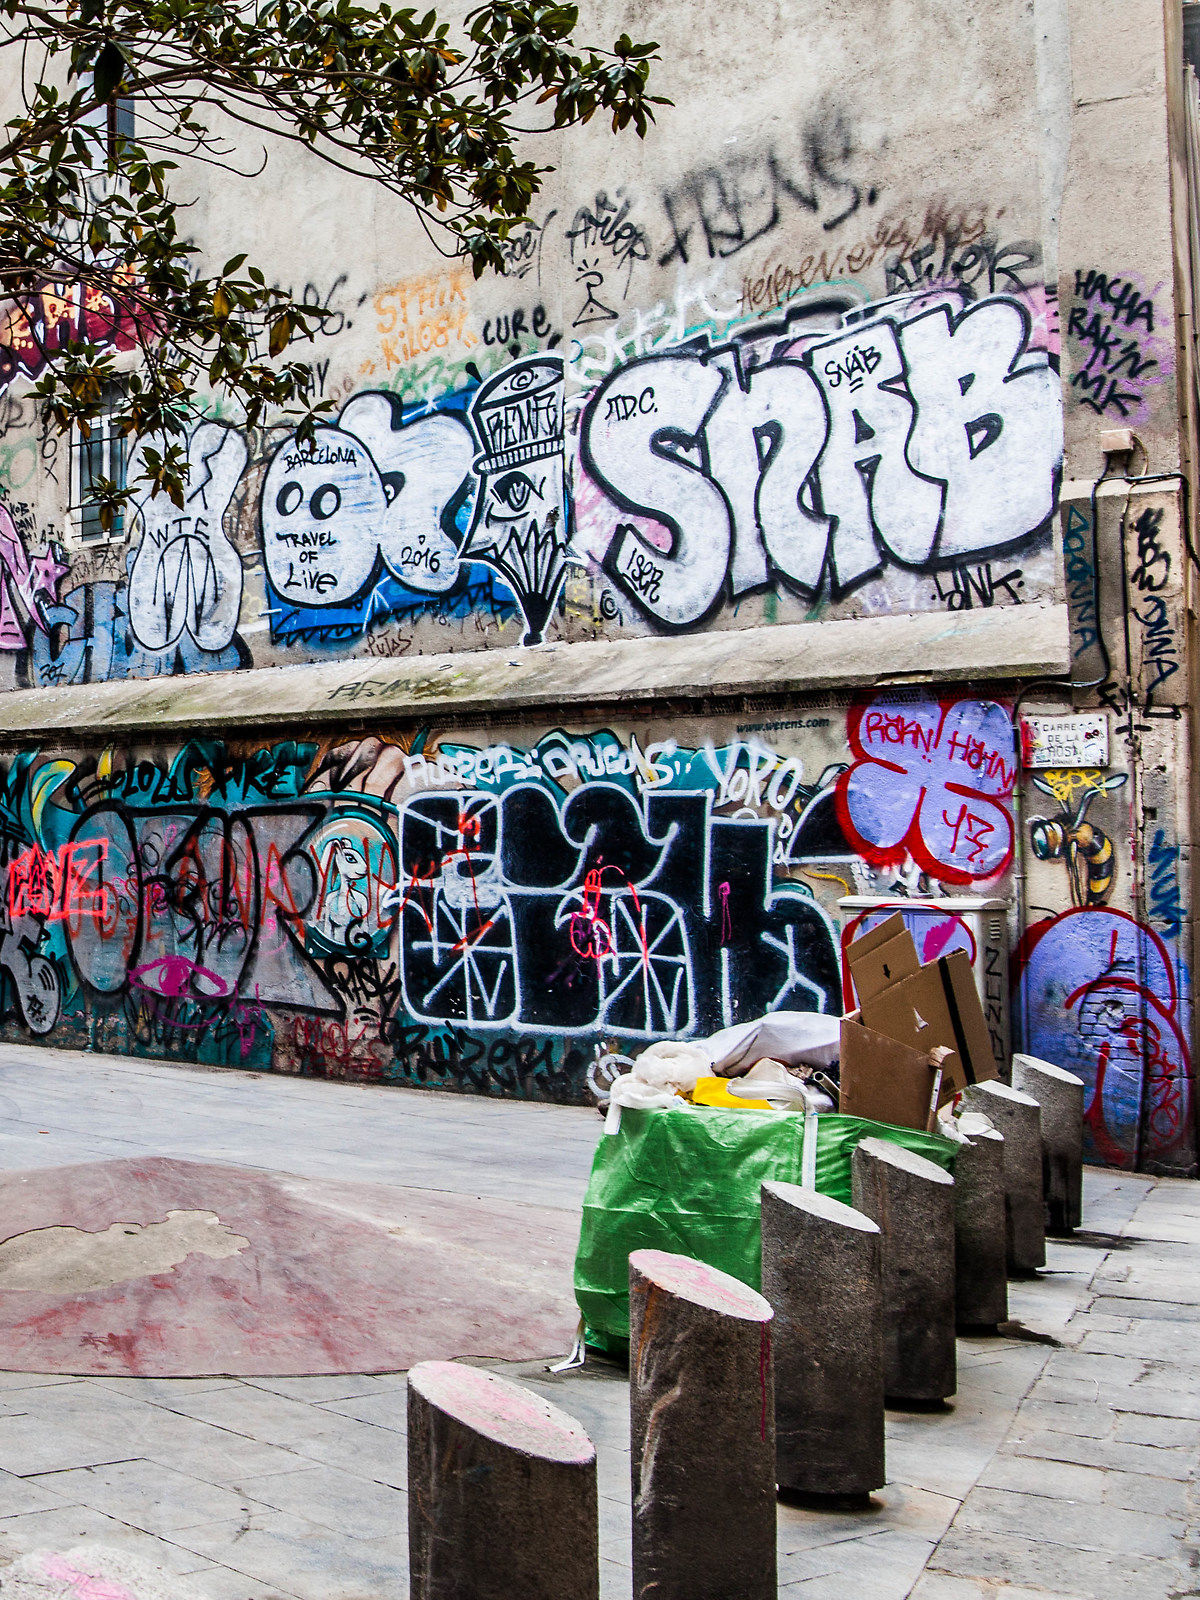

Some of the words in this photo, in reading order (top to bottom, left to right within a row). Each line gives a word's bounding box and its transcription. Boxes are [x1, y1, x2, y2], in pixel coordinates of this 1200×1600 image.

[284, 445, 357, 473] BARCELONA
[276, 531, 338, 548] TRAVEL
[300, 551, 318, 564] OF
[401, 546, 441, 573] 2016
[737, 718, 830, 733] www.werens.com
